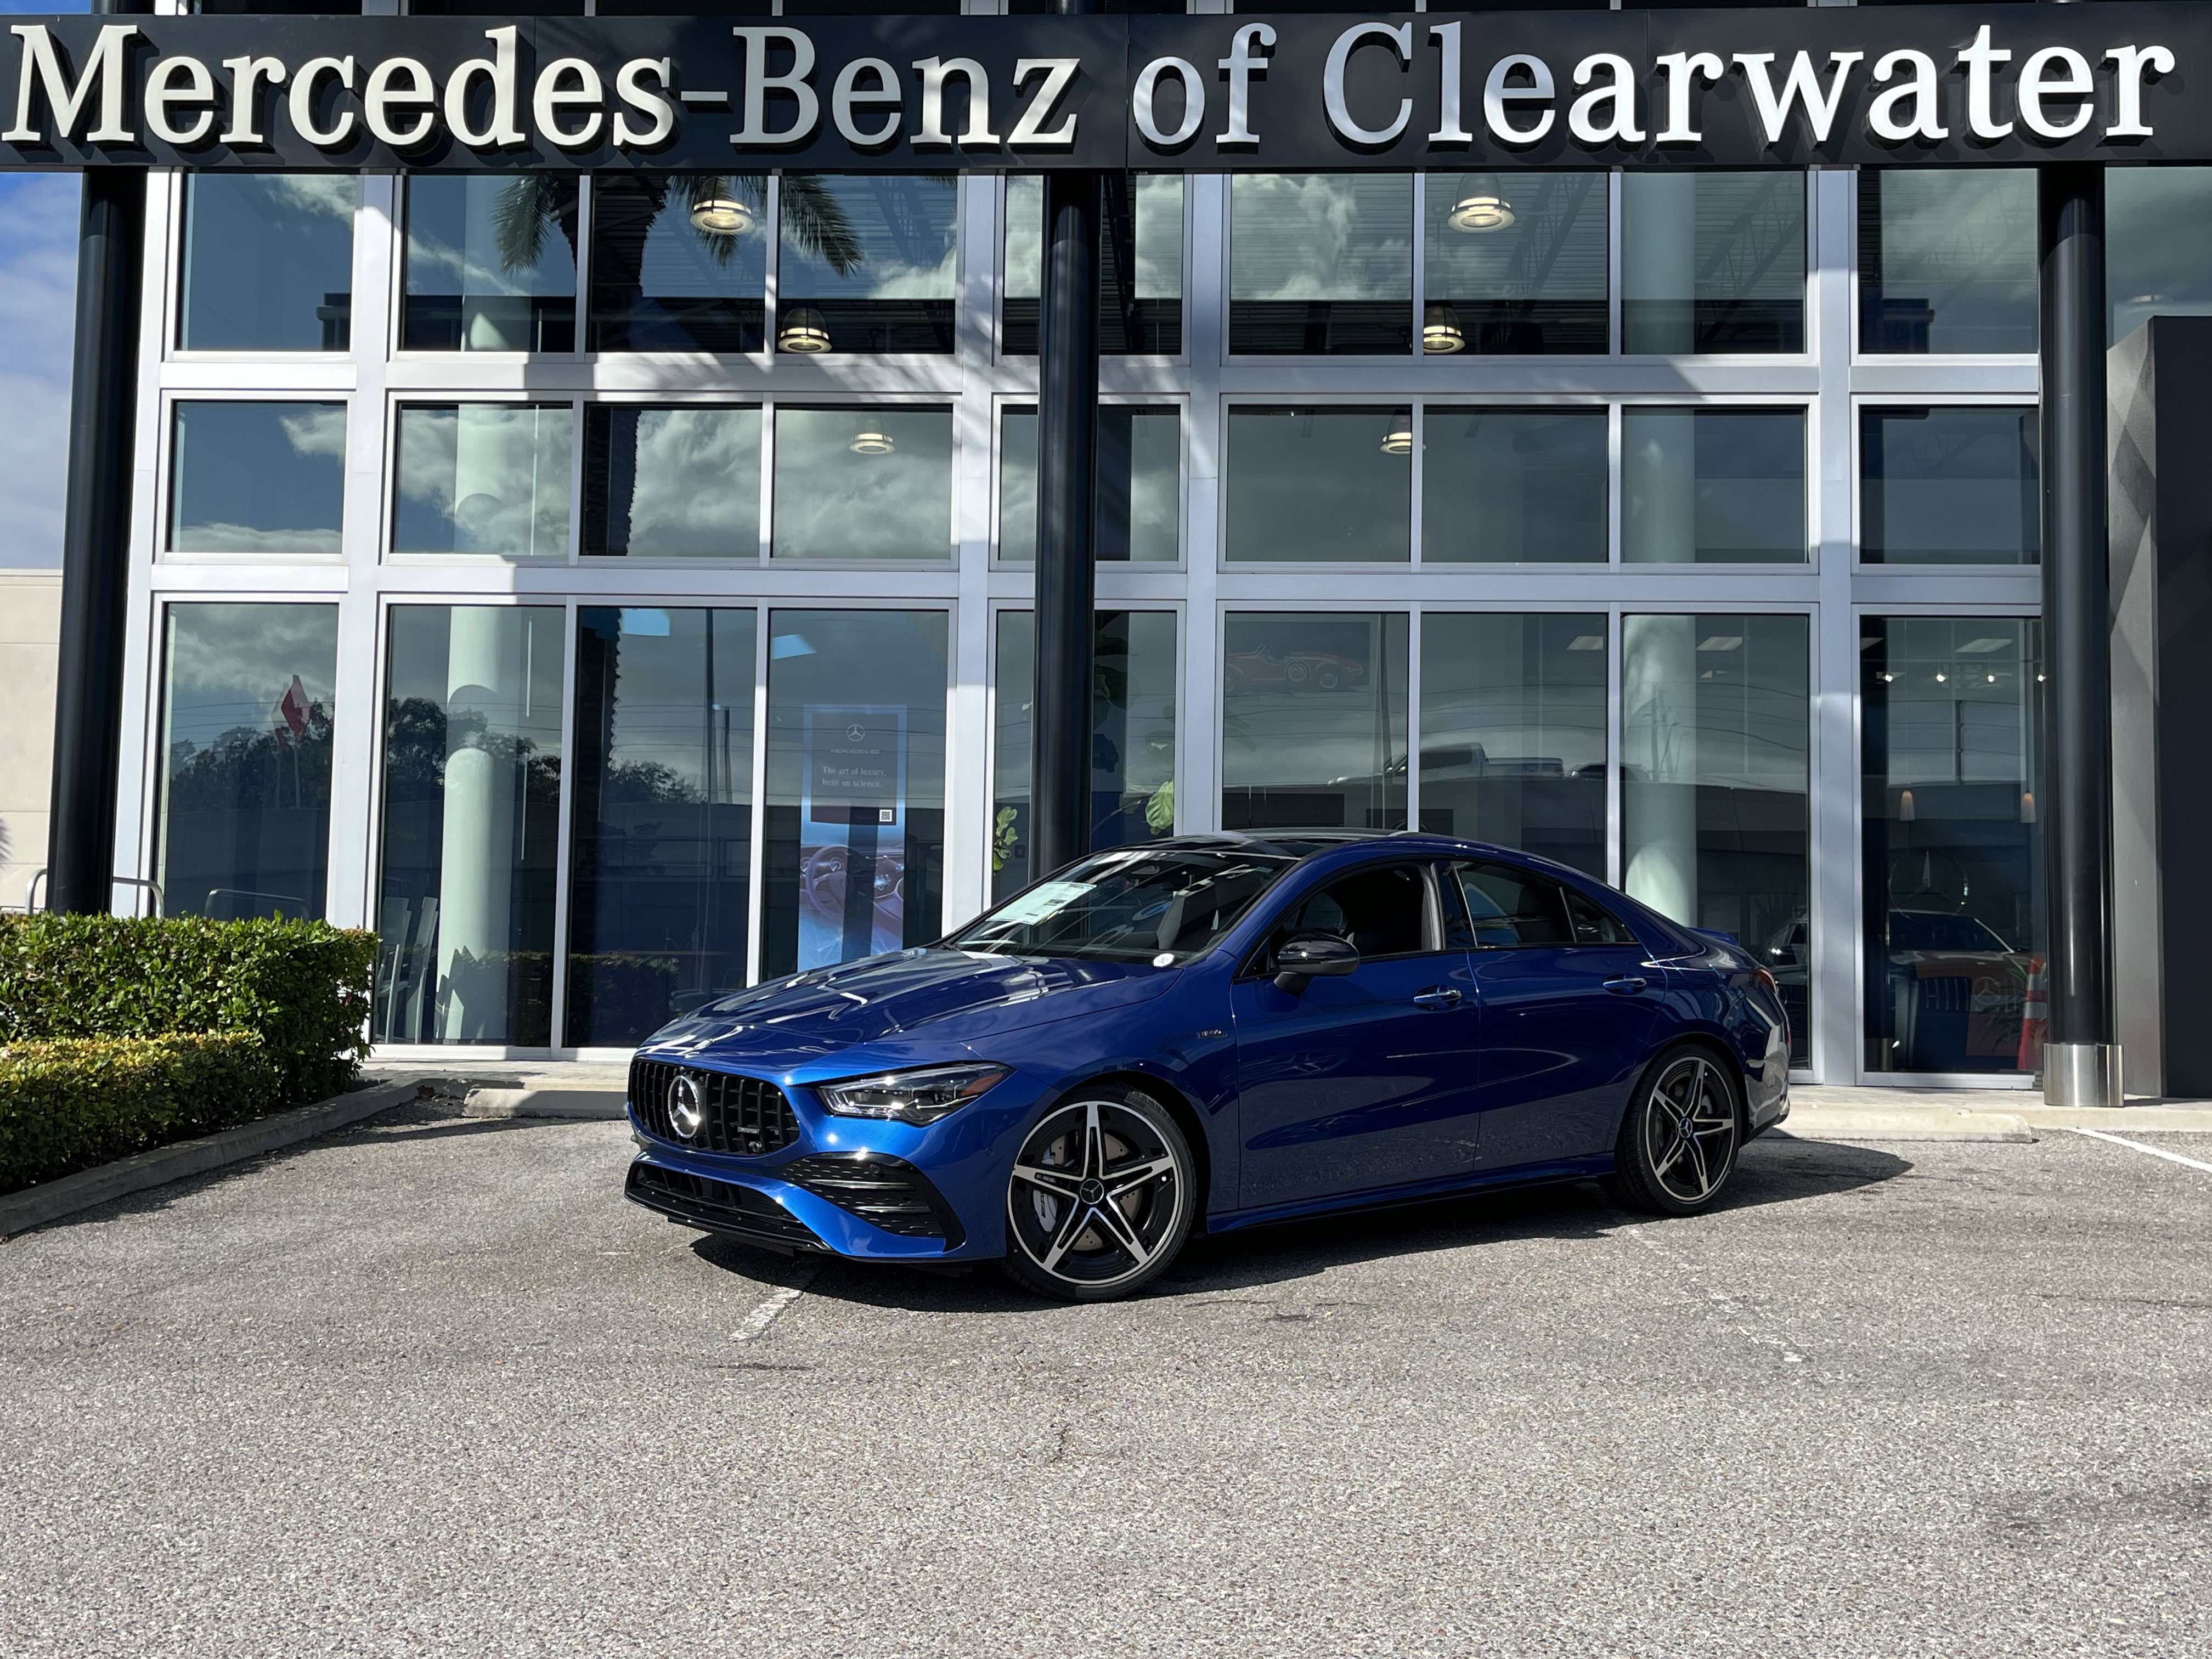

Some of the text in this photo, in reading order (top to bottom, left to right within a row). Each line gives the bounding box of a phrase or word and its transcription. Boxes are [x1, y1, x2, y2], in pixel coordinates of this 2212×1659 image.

[1, 21, 2176, 146] Mercedes-Benz of Clearwater
[822, 766, 837, 775] The
[851, 767, 859, 775] of
[822, 777, 840, 786] built
